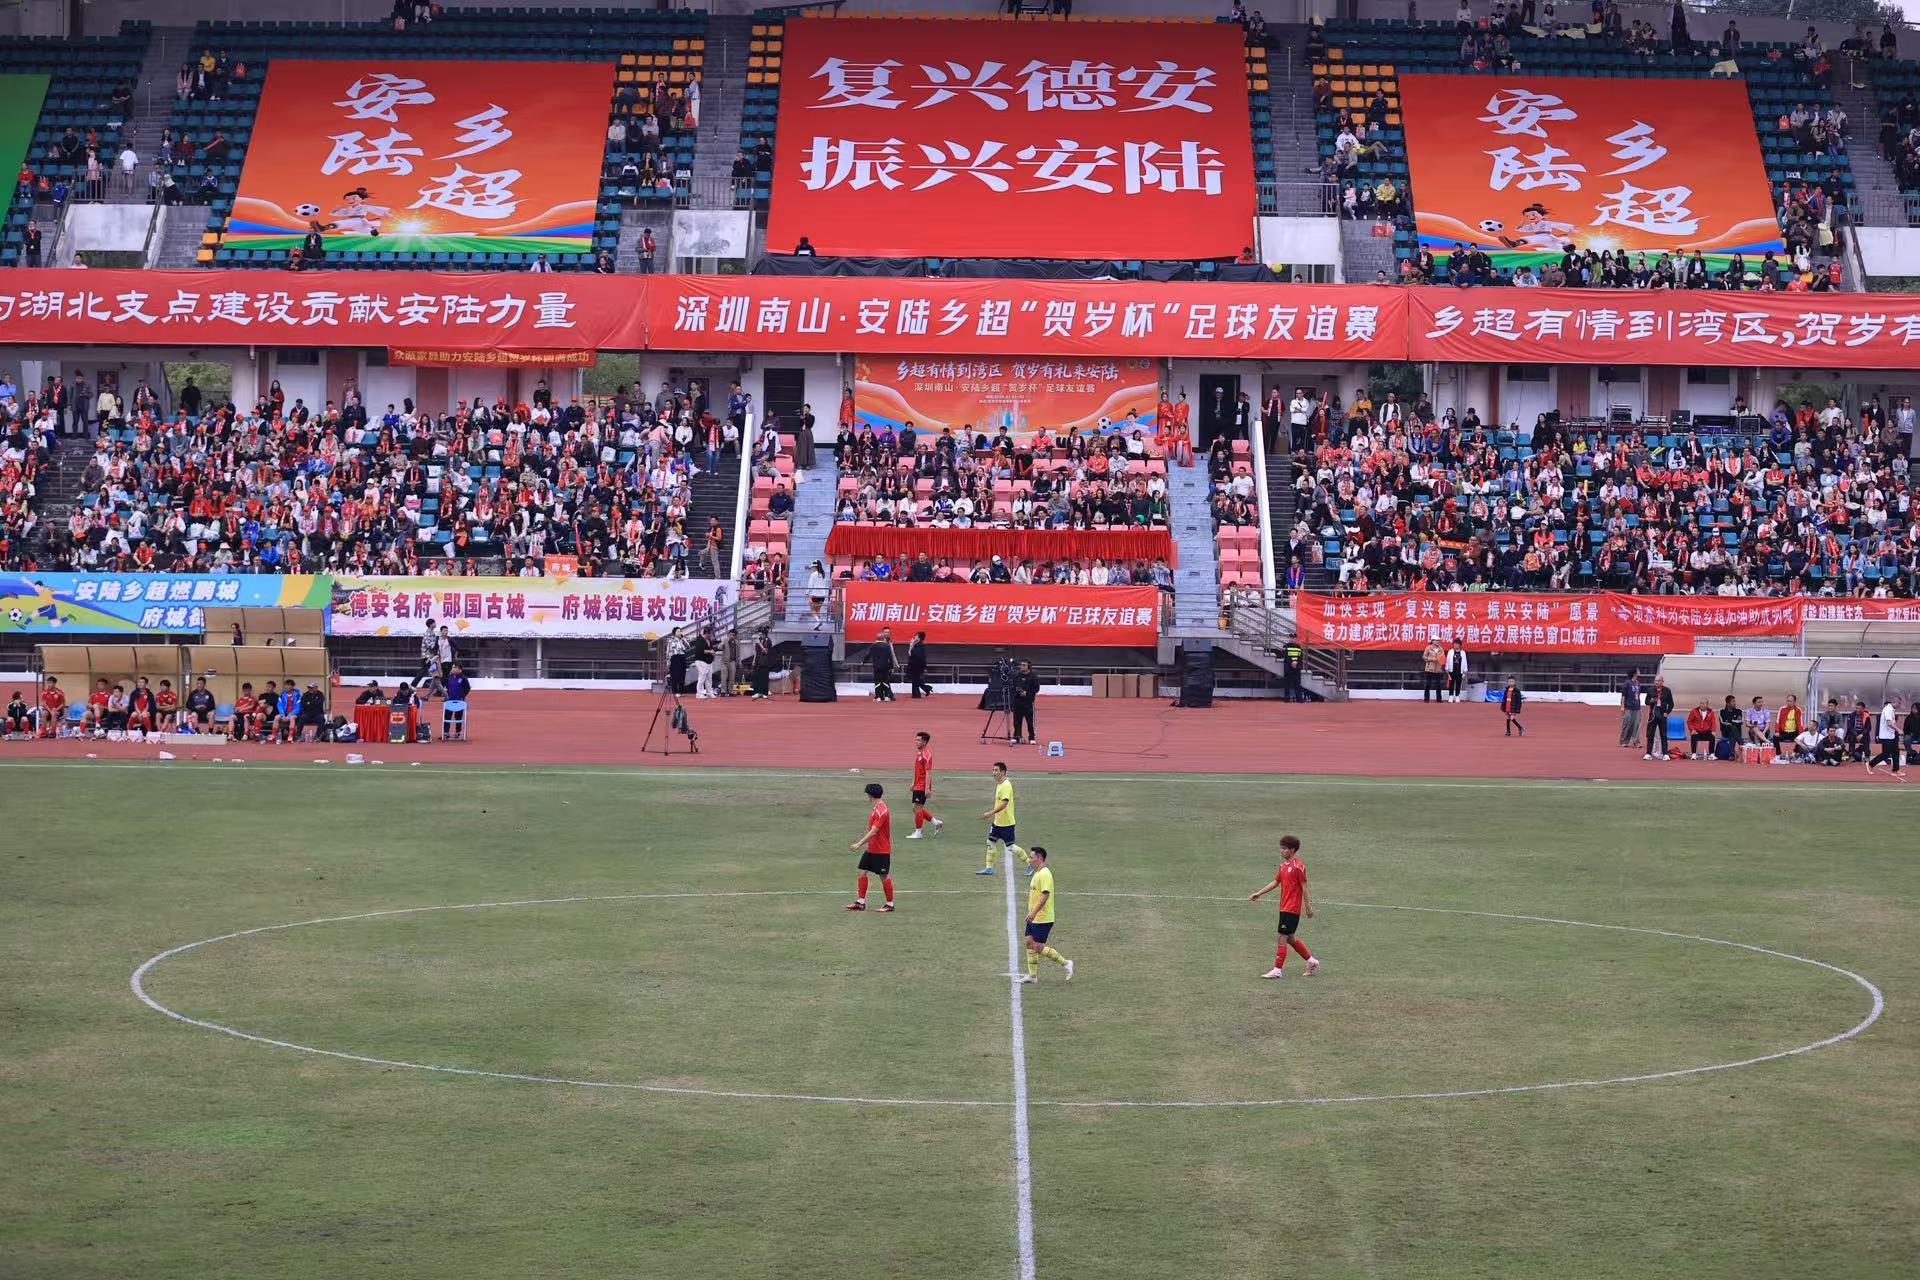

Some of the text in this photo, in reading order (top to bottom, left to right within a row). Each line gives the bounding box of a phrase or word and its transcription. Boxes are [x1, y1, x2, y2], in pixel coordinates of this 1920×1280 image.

[805, 56, 1217, 113] 复兴德安
[321, 73, 434, 176] 安陆
[1477, 88, 1586, 192] 安陆
[405, 103, 522, 220] 乡超
[798, 136, 1226, 195] 振兴安陆
[1589, 120, 1704, 236] 乡超
[897, 361, 1118, 384] 乡超有情到湾区 贺岁有礼来安陆
[75, 580, 240, 602] 安陆乡超燃鹏城
[350, 592, 433, 619] 德安名府
